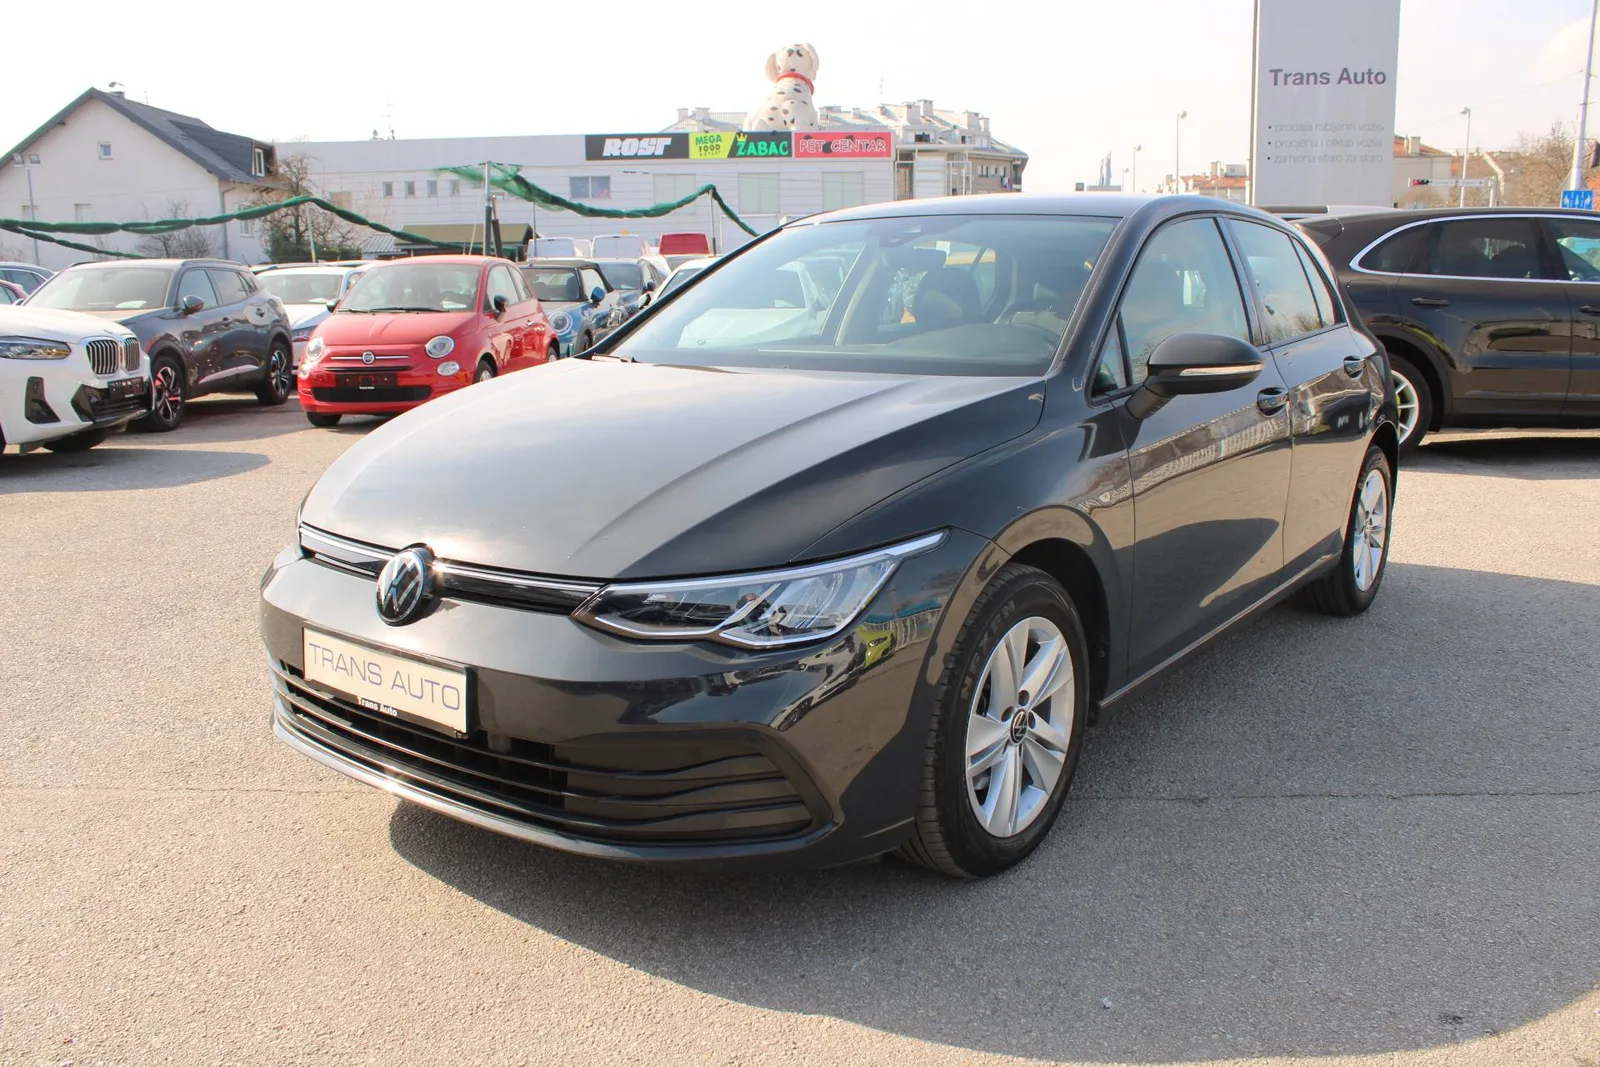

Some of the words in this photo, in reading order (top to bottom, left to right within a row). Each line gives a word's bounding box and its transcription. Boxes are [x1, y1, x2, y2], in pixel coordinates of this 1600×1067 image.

[1269, 68, 1331, 86] Trans
[1337, 67, 1387, 85] Auto
[602, 137, 672, 157] ROST
[695, 134, 722, 145] MEGA
[699, 144, 721, 152] FOOD
[800, 139, 825, 153] PET
[831, 139, 886, 153] CENTAR
[960, 599, 1016, 700] NEXEN
[308, 642, 382, 686] TRANS
[391, 670, 460, 711] AUTO
[357, 696, 379, 710] Trans
[380, 703, 398, 717] Auto
